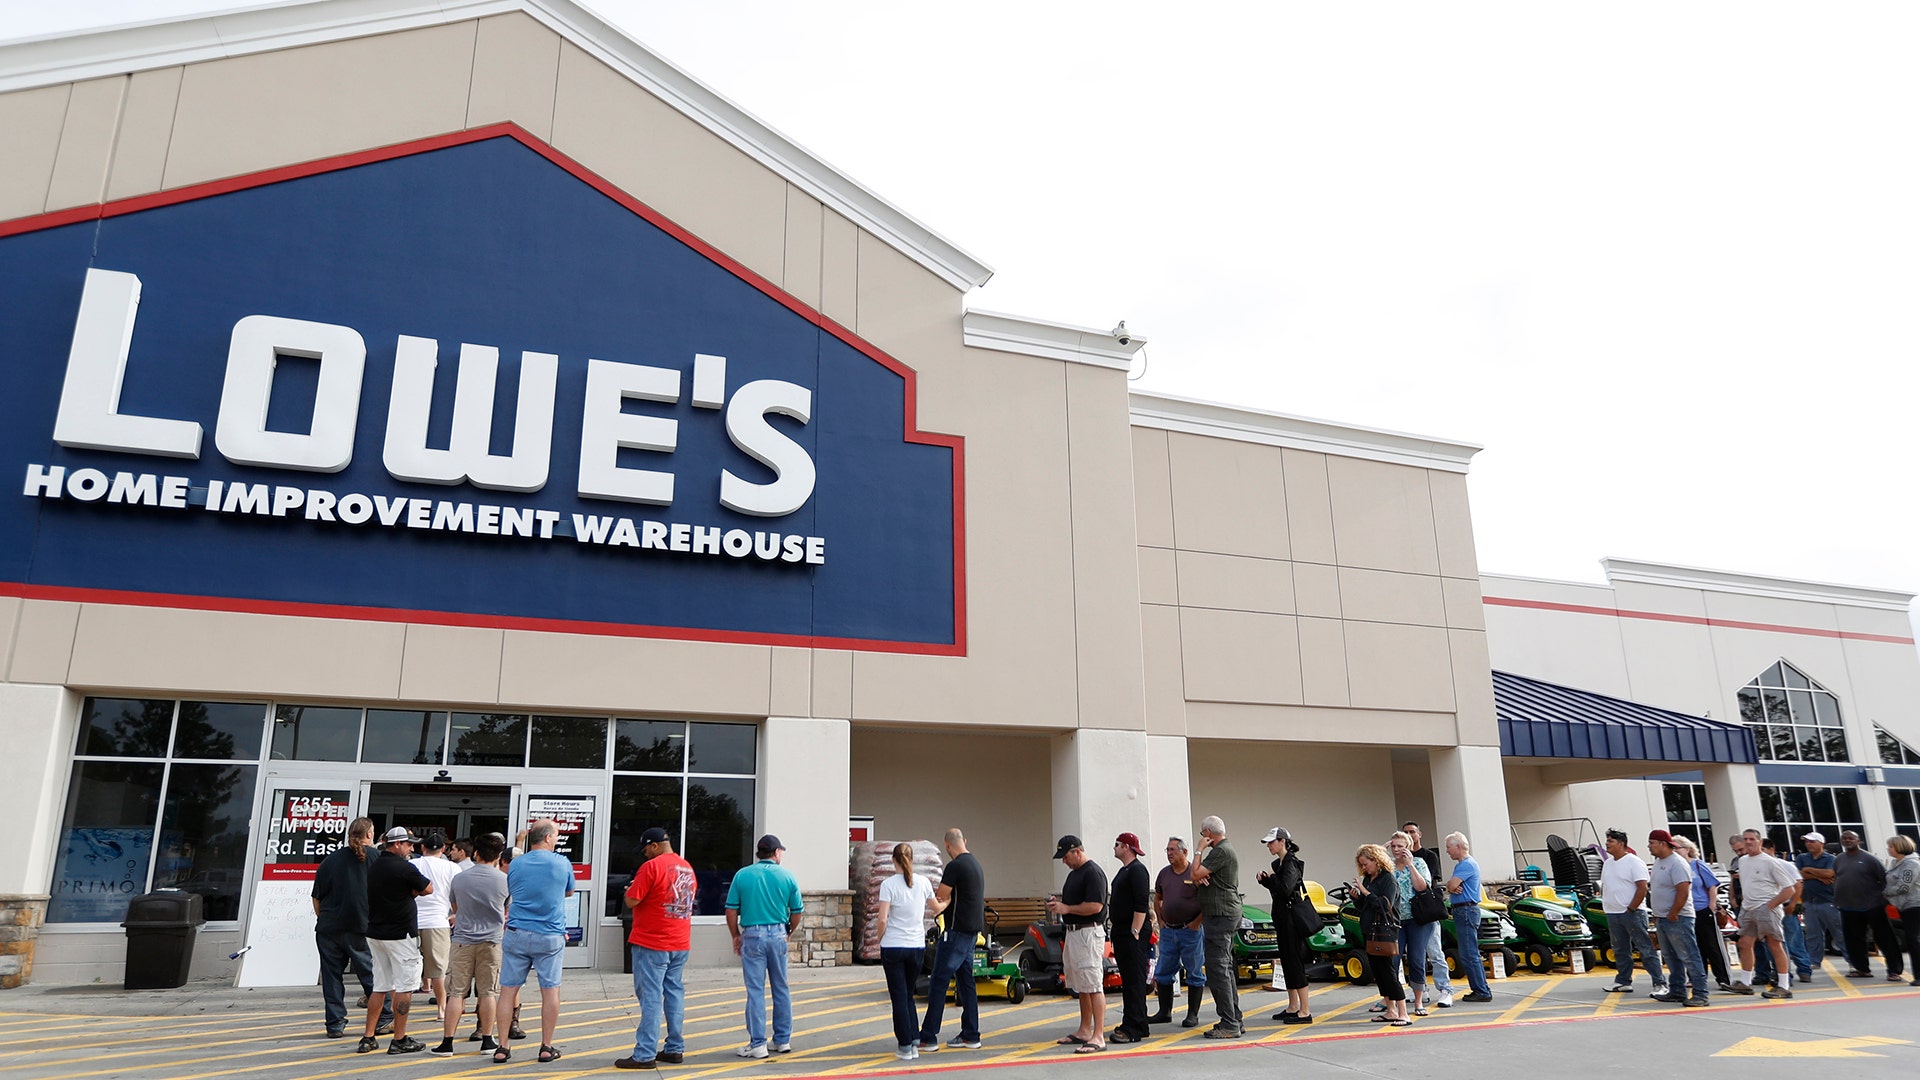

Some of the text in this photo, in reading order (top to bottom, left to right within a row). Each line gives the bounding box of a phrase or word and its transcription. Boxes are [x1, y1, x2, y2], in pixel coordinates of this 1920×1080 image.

[53, 267, 816, 517] LOWE'S
[23, 464, 826, 566] HOME IMPROVEMENT WAREHOUSE
[289, 796, 332, 812] 7355
[269, 817, 297, 833] FM
[306, 818, 345, 834] 1960
[266, 839, 297, 855] Rd.
[57, 880, 135, 894] PRIMO
[294, 887, 312, 896] WIL
